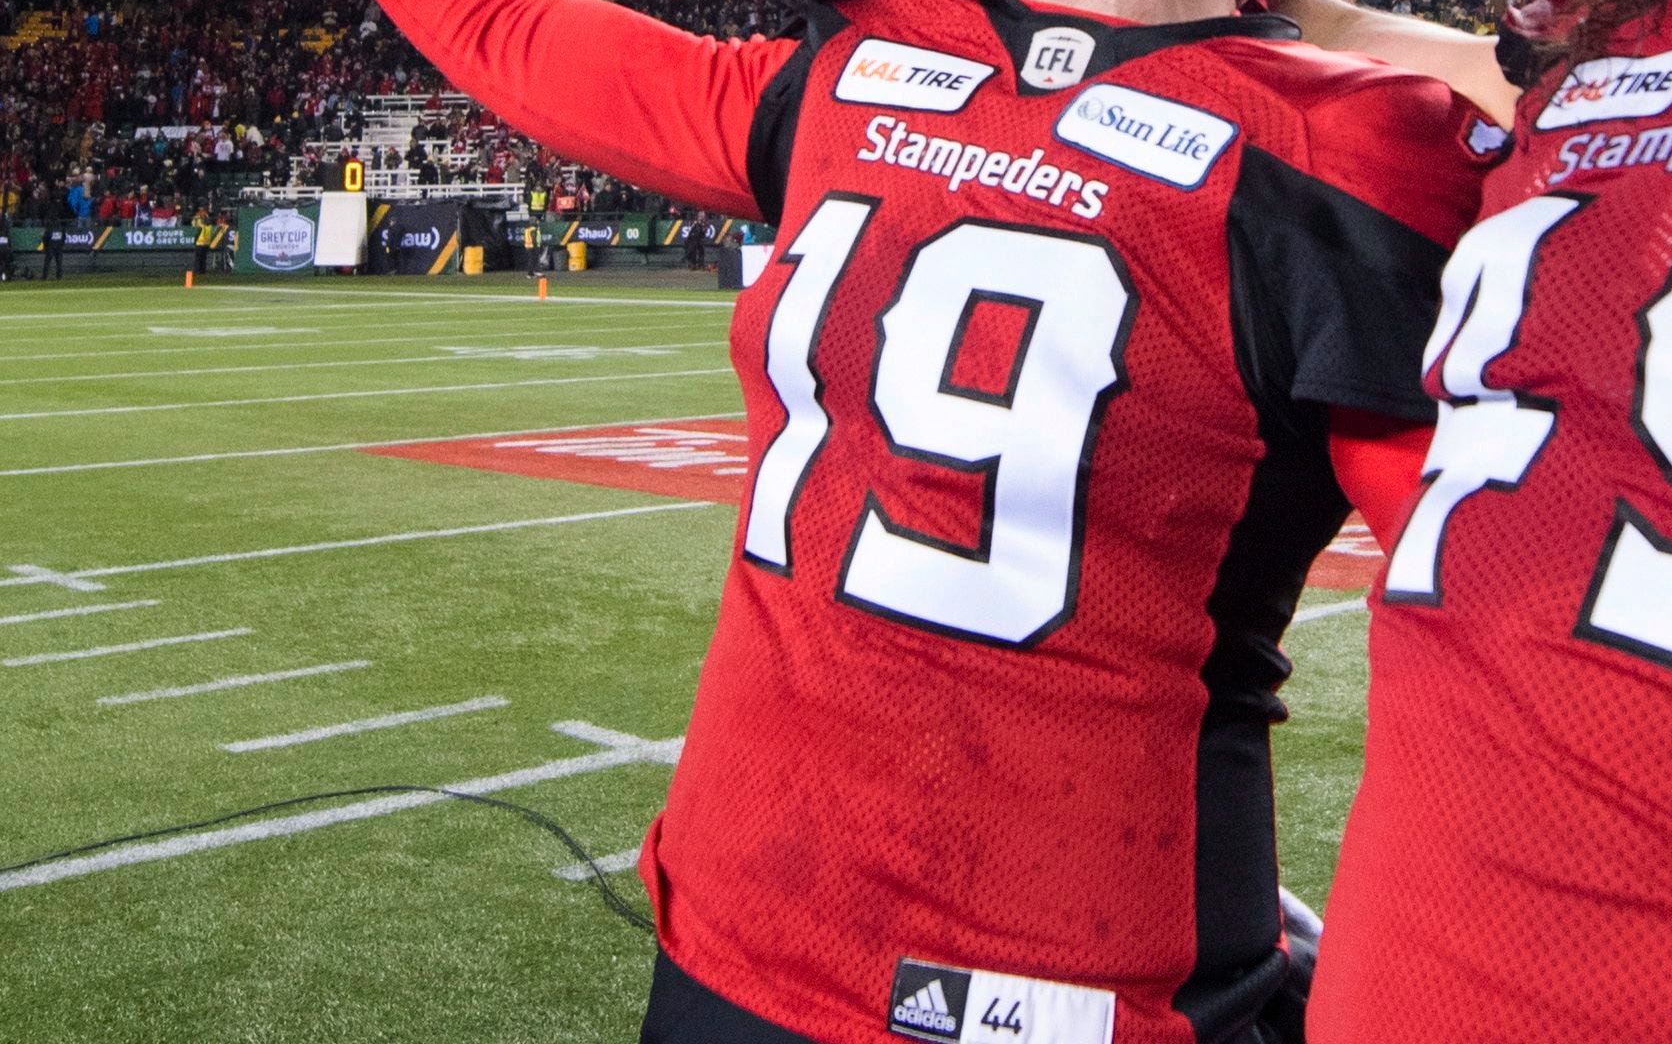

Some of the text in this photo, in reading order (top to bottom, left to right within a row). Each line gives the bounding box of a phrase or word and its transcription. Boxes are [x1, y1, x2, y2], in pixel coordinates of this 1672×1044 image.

[1033, 45, 1075, 73] CFL
[1100, 105, 1211, 162] Sun Life
[344, 161, 363, 191] 0
[857, 115, 1109, 220] Stampeders
[125, 231, 154, 245] 106
[260, 231, 308, 243] GREY CUP
[741, 190, 1141, 648] 19
[894, 997, 1023, 1035] adidas 44
